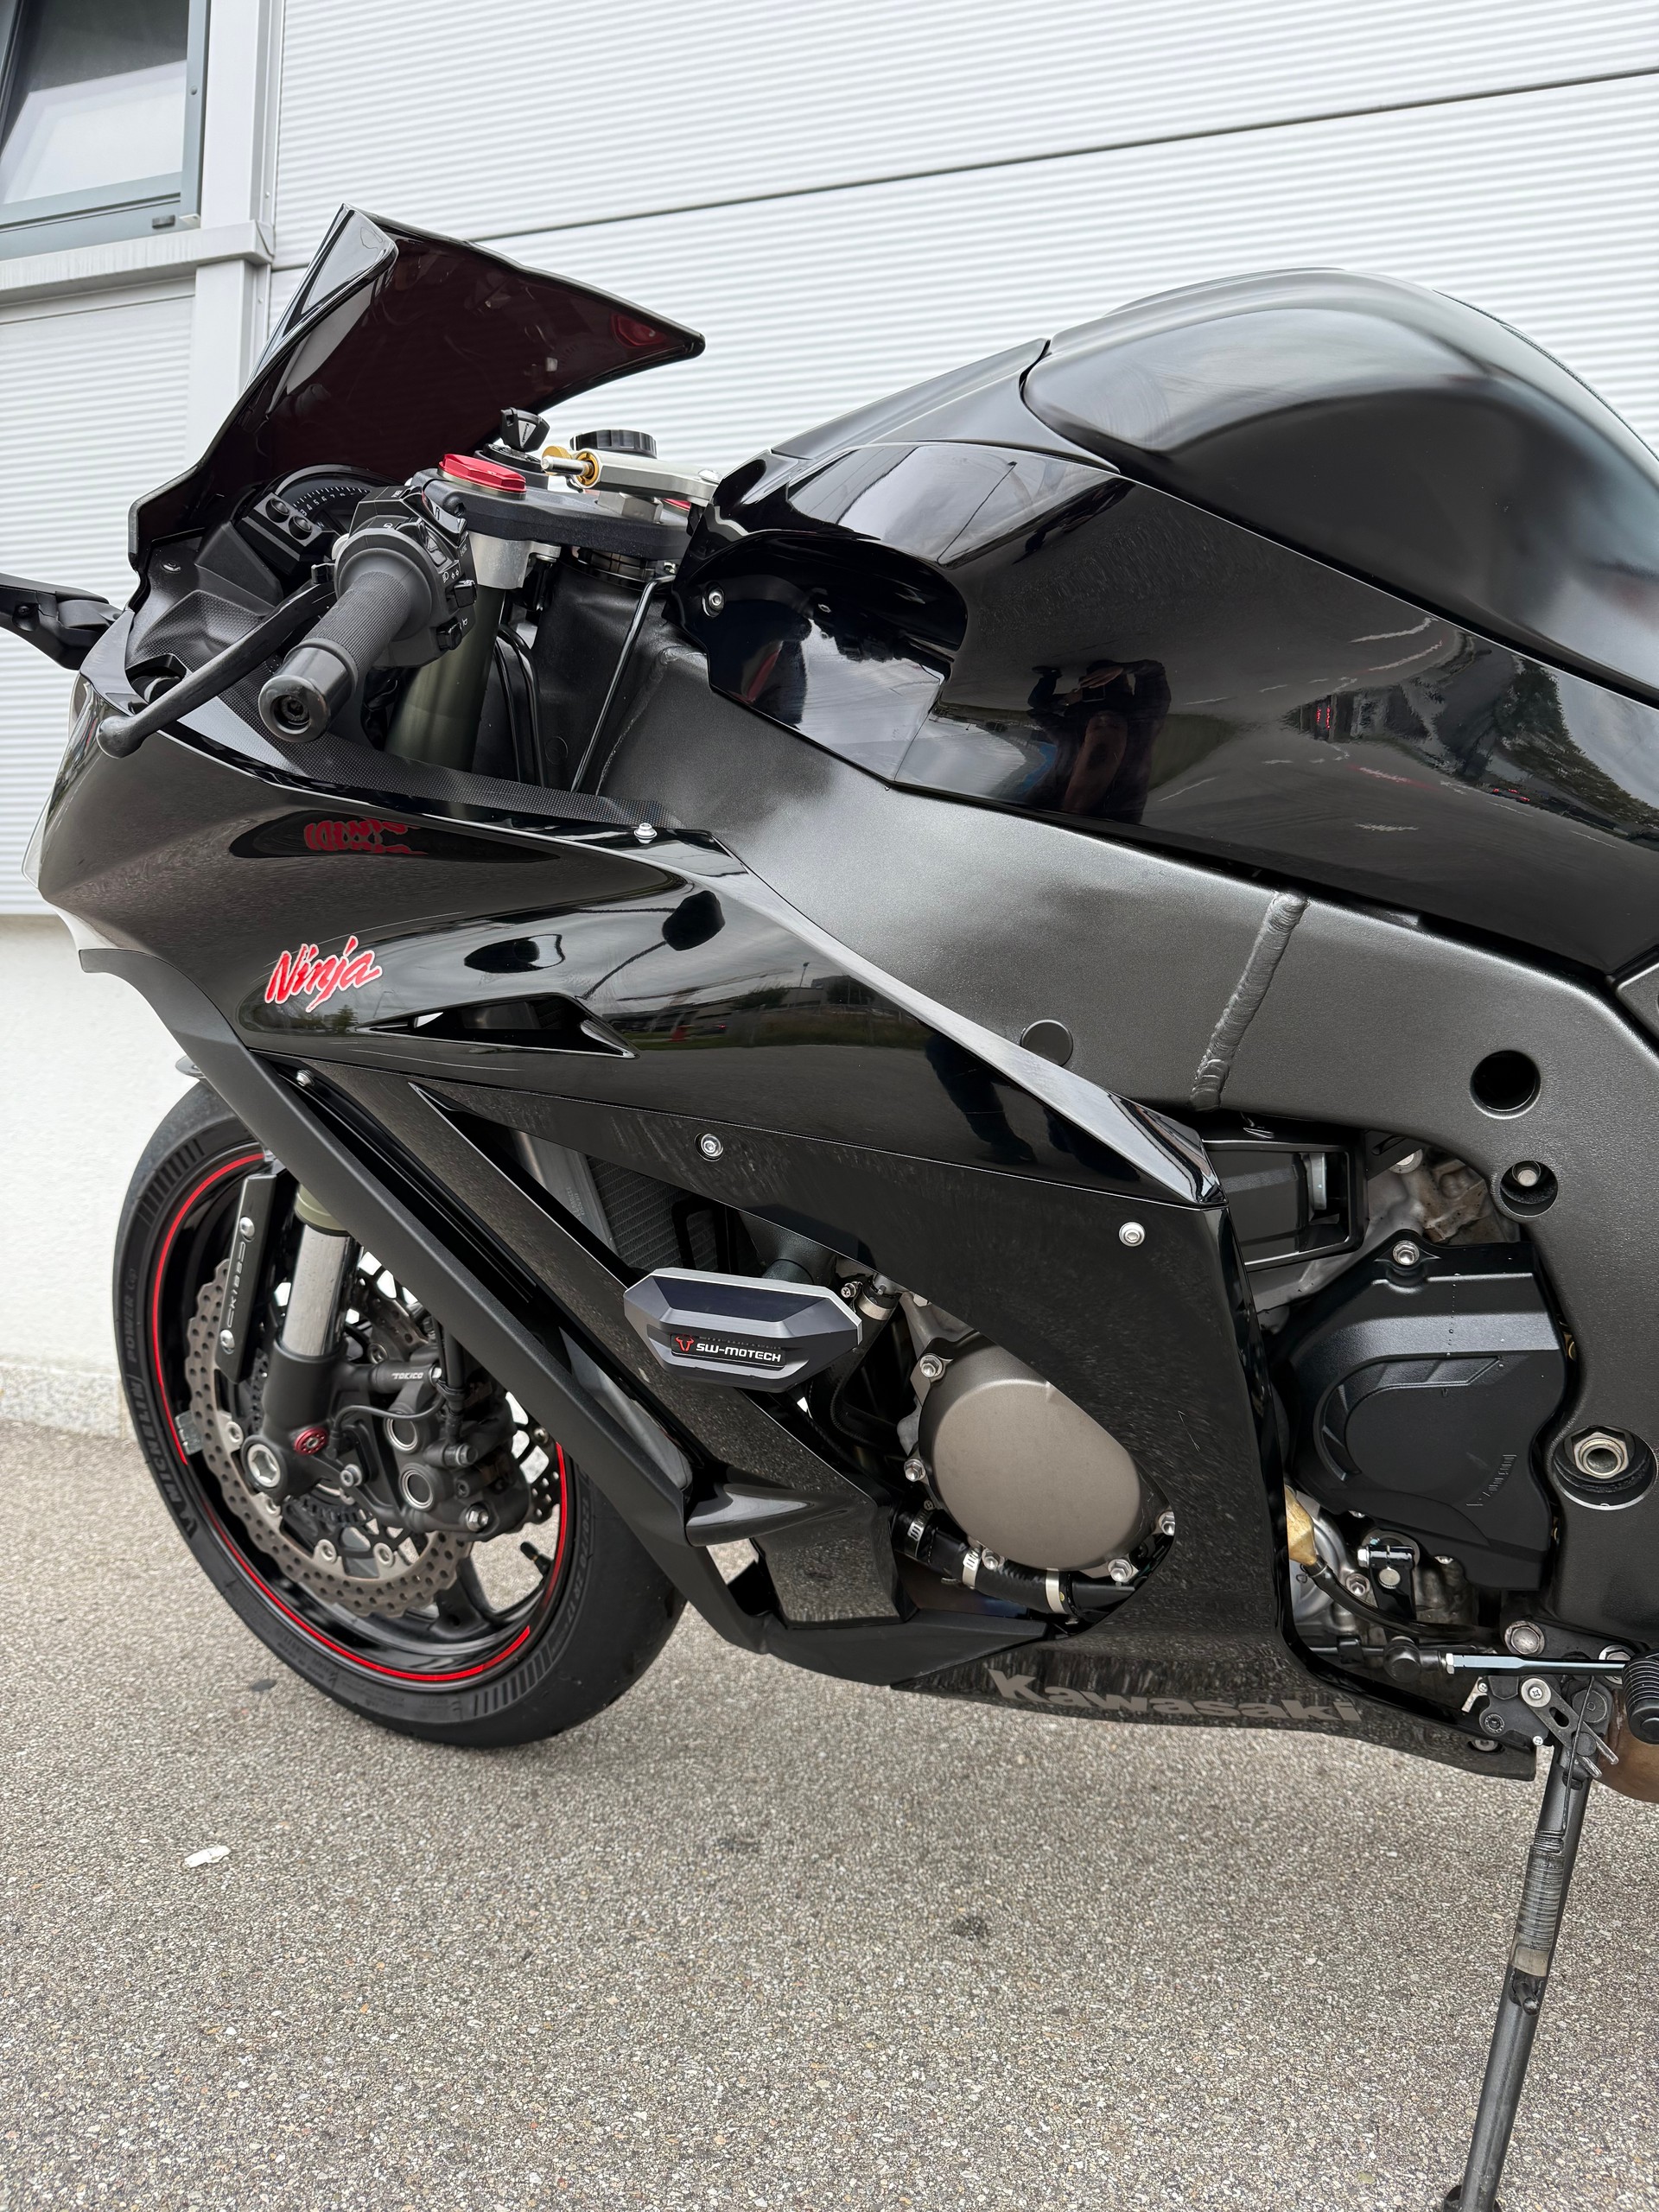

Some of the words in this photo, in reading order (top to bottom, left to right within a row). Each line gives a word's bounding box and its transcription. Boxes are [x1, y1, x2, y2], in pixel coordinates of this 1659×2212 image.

[264, 935, 382, 1013] Ninja
[124, 1294, 137, 1363] POWER
[696, 1343, 782, 1363] SW-MOTECH
[391, 1371, 424, 1380] TOKICO
[130, 1382, 182, 1504] MICHELIN
[580, 1497, 589, 1568] 120/70
[988, 1669, 1362, 1722] Kawasaki
